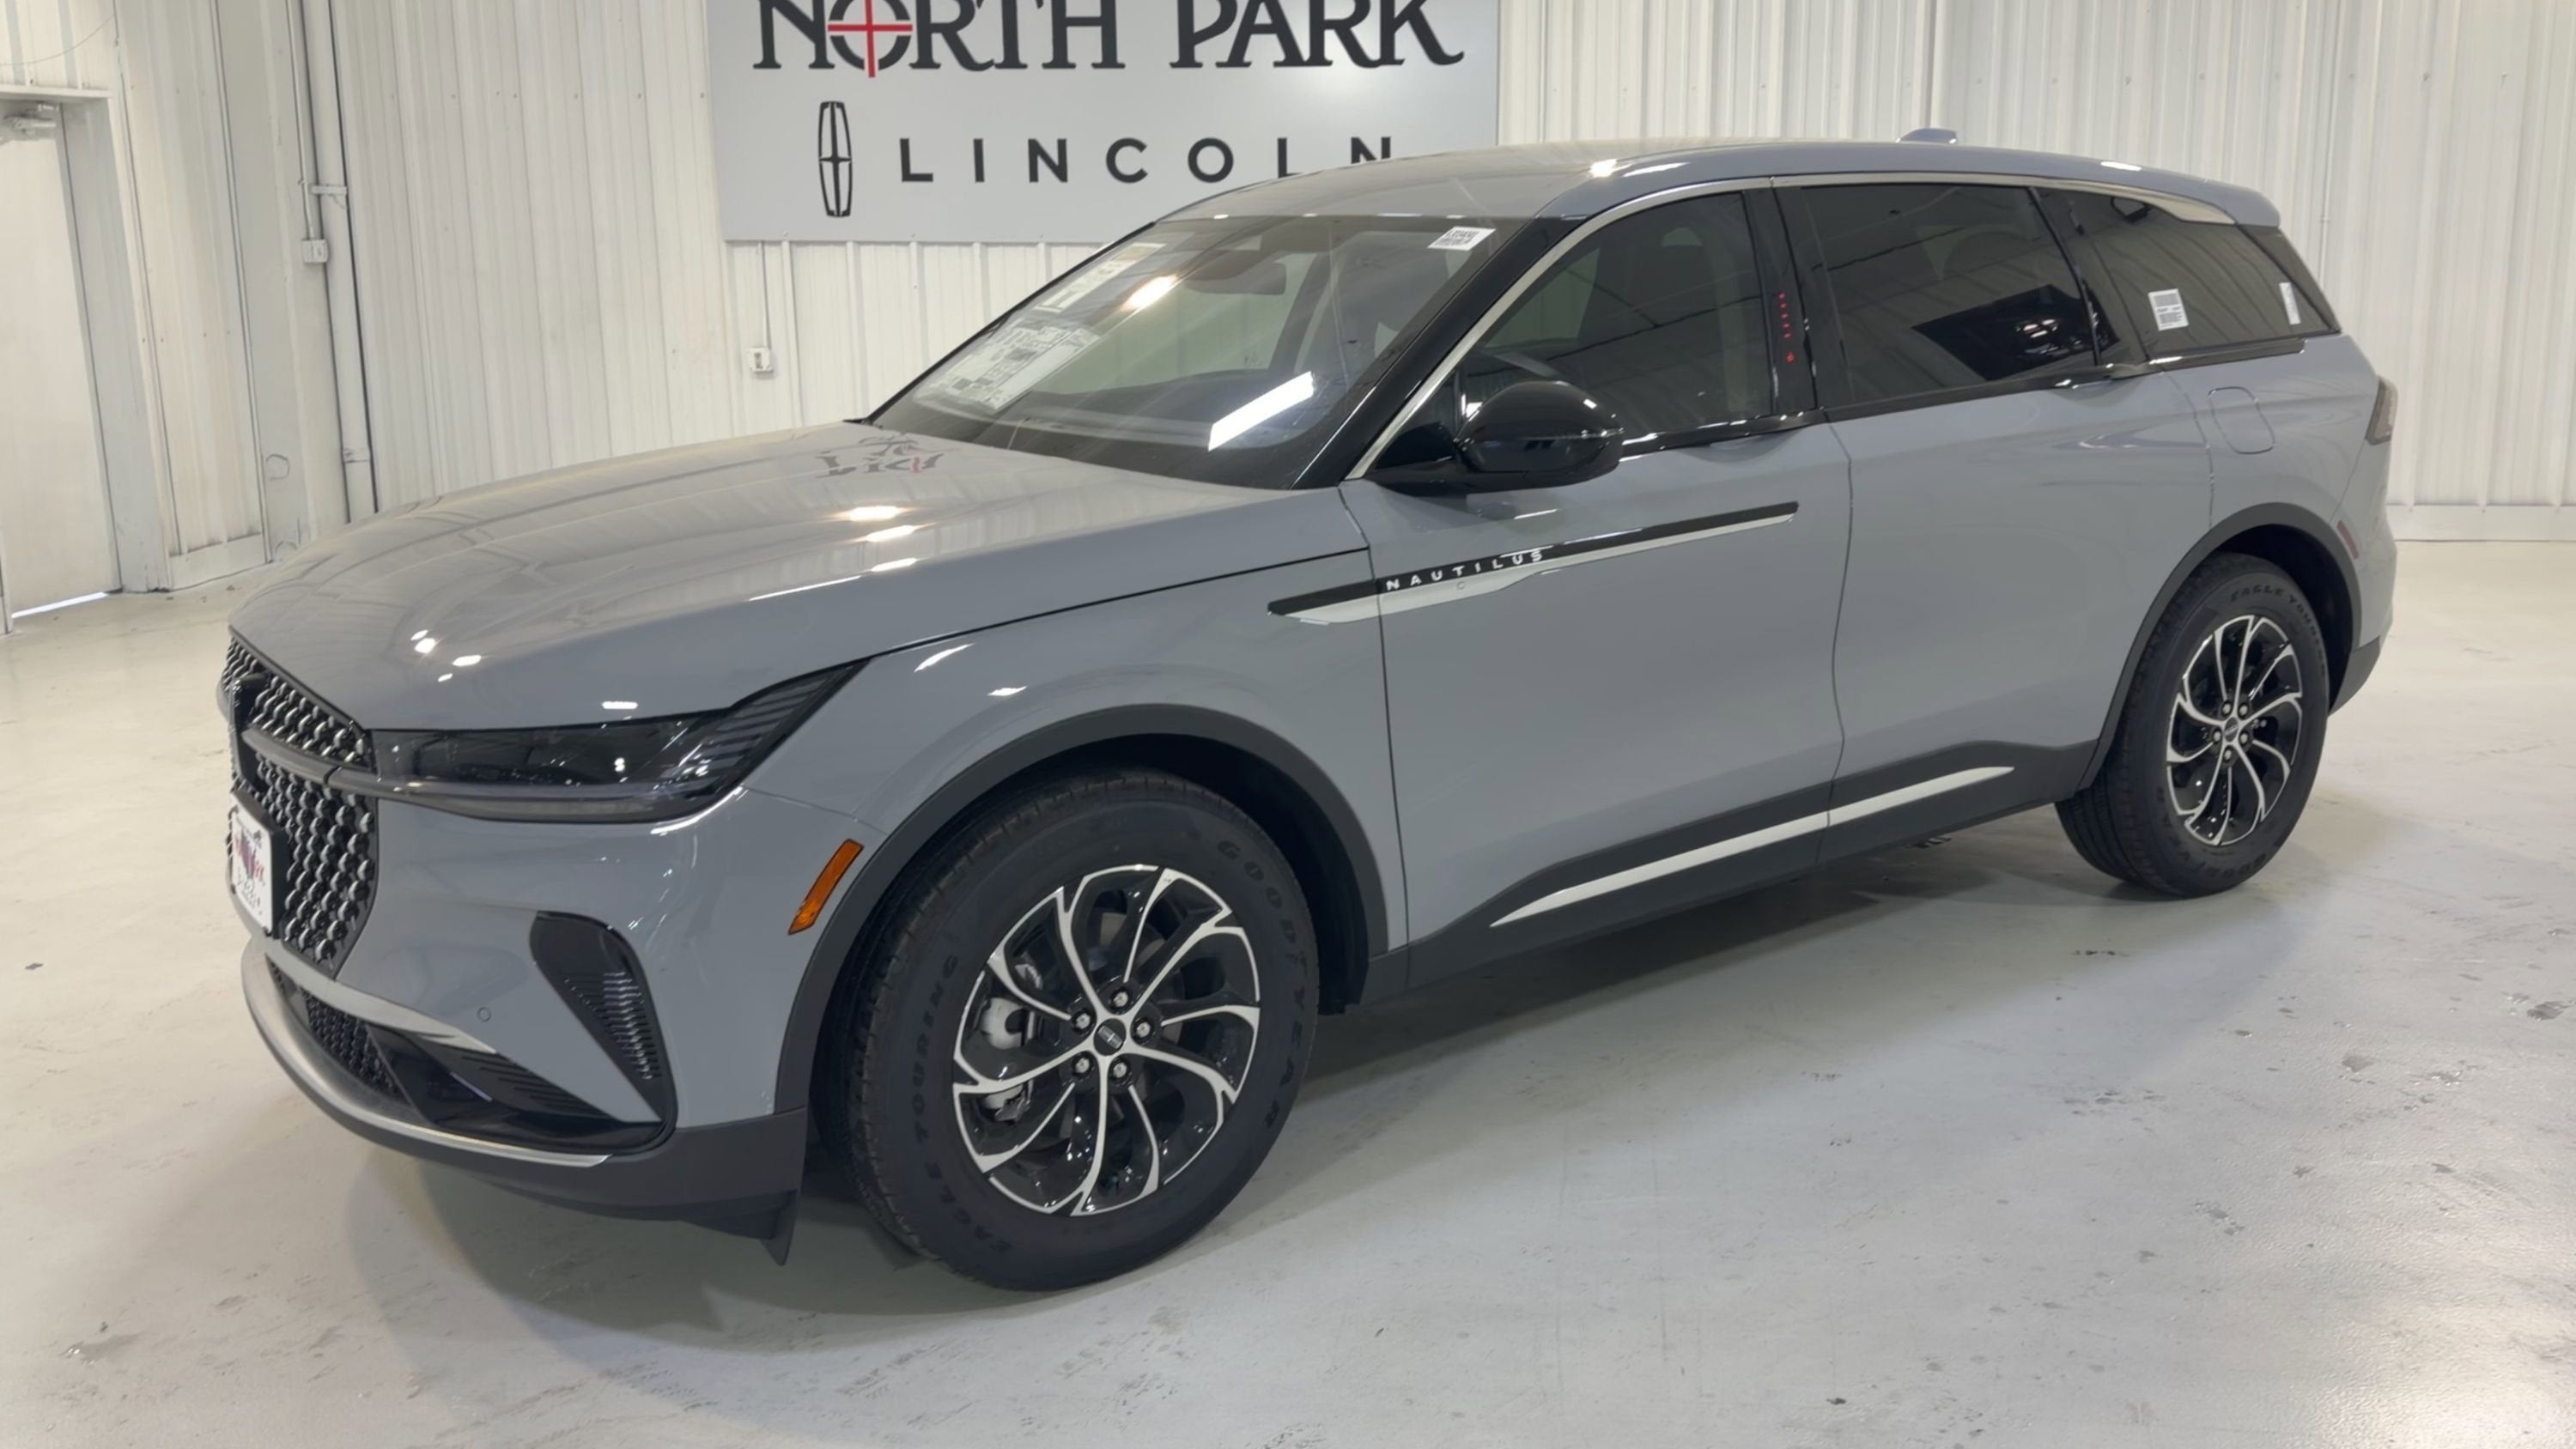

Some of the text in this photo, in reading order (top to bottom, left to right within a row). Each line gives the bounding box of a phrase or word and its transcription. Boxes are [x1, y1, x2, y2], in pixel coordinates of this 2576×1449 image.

[752, 0, 1465, 77] NORTH PARK
[899, 136, 1392, 183] LINCOLN
[1386, 549, 1543, 591] NAUTILUS
[1216, 839, 1309, 1131] GOODYEAR
[912, 953, 959, 1145] TOURING
